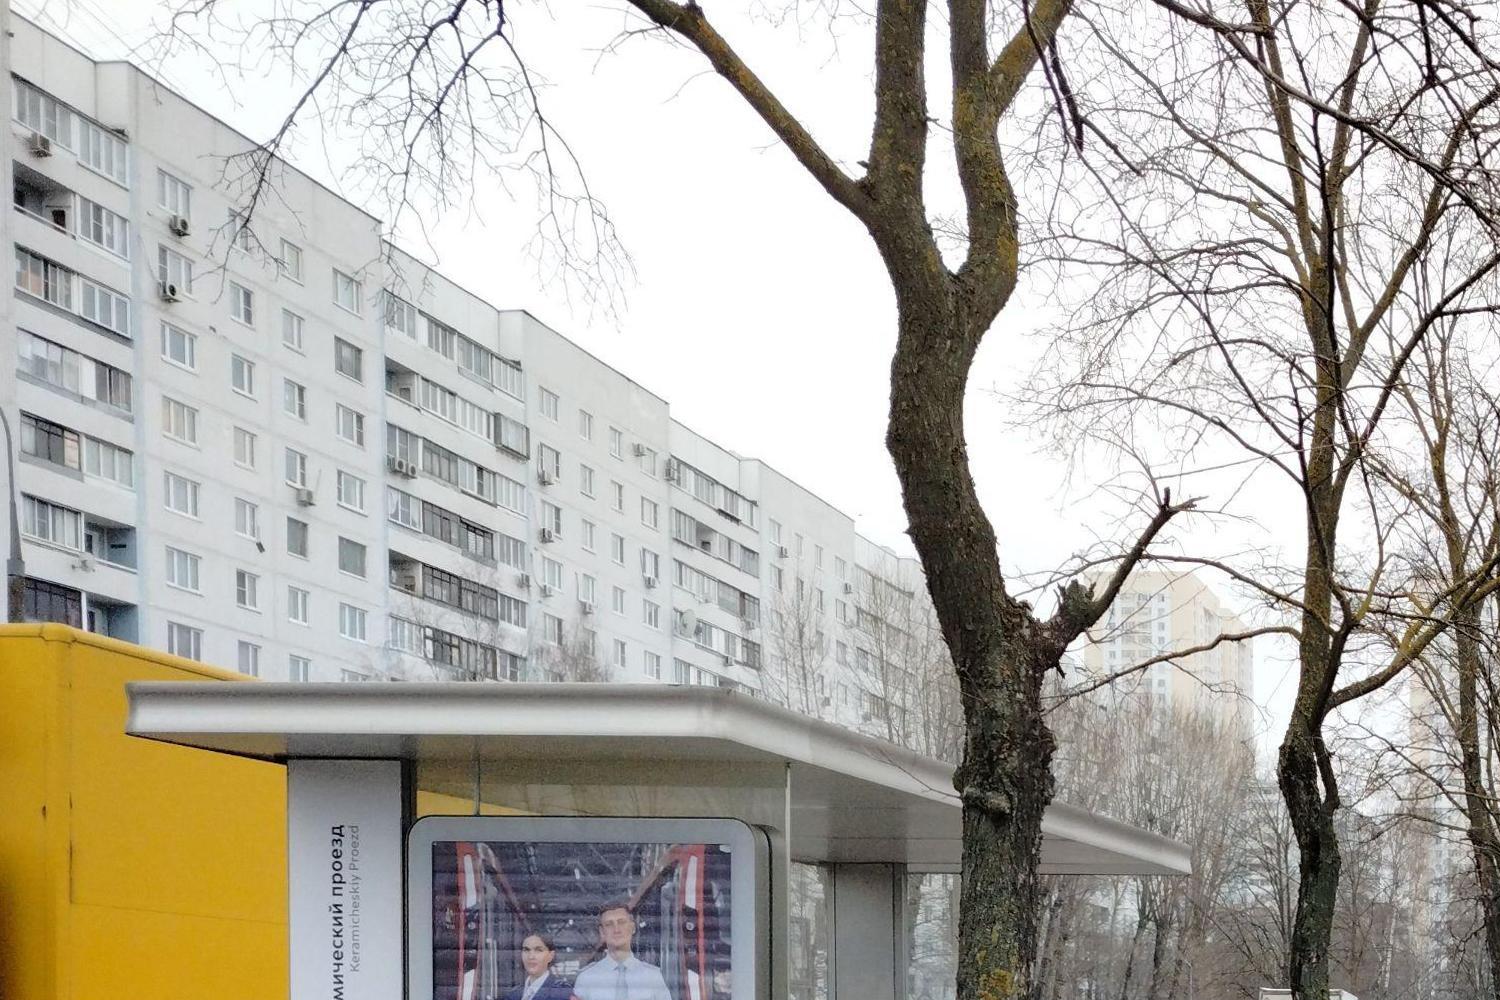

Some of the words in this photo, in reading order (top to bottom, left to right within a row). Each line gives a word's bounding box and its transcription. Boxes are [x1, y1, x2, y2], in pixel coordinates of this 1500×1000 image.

[331, 824, 347, 897] проезд
[347, 825, 360, 871] Proezd
[348, 874, 362, 973] Keramicheskiy
